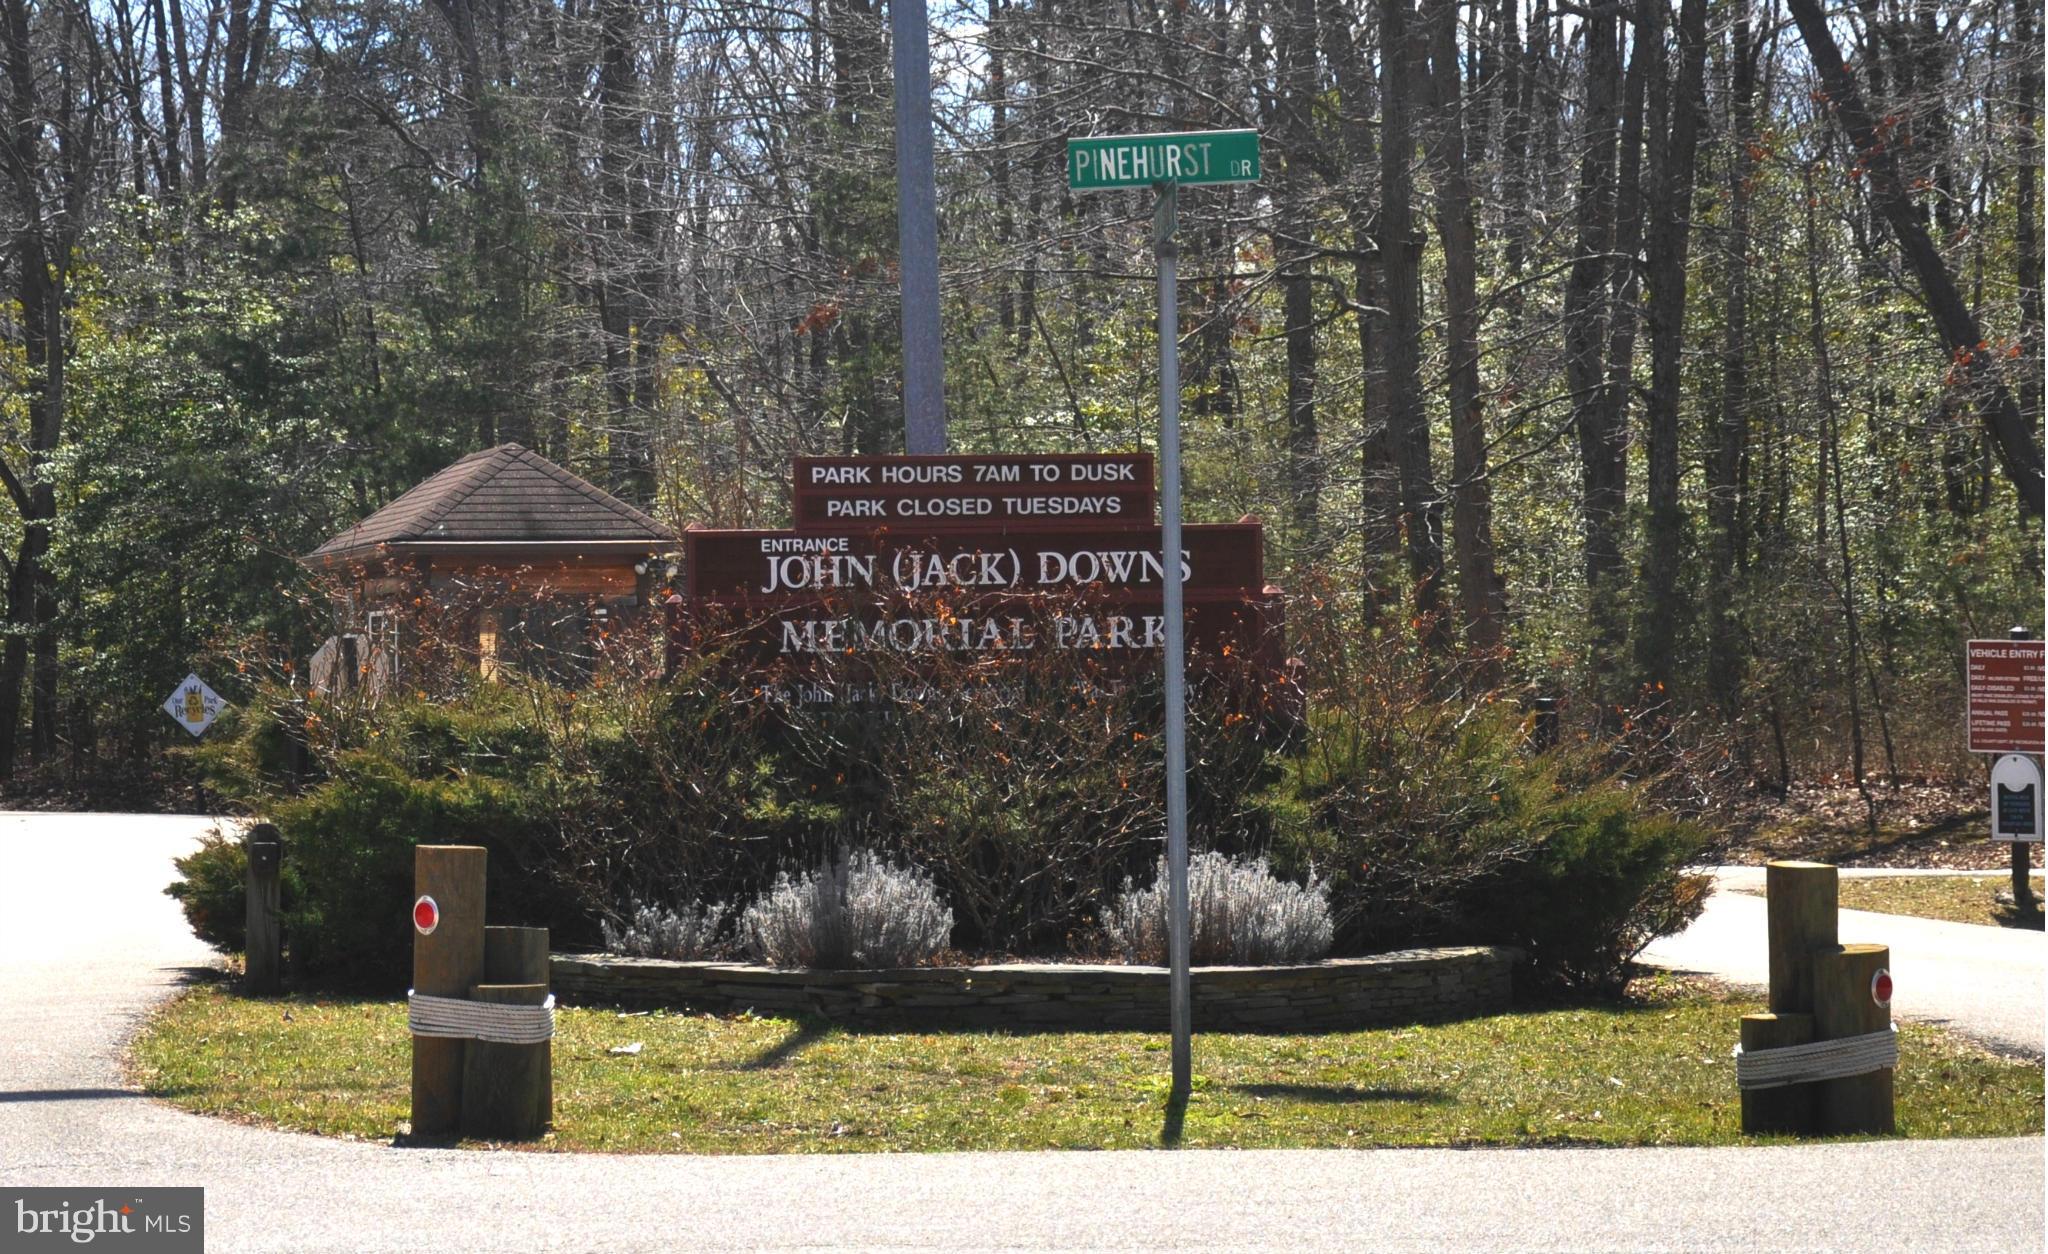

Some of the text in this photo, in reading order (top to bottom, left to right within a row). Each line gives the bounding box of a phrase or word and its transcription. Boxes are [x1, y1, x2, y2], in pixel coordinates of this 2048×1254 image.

[1074, 142, 1252, 182] PINEHURST DR
[811, 463, 1135, 484] PARK HOURS 7AM TO DUSK
[827, 496, 1122, 517] PARK CLOSED TUESDAYS
[761, 537, 849, 553] ENTRANCE
[761, 554, 878, 593] JOHN
[892, 547, 1021, 592] (JACK)
[779, 615, 1166, 653] MEMORIAL PARK
[1970, 649, 2008, 659] VEHICLE
[2009, 649, 2038, 659] ENTRY
